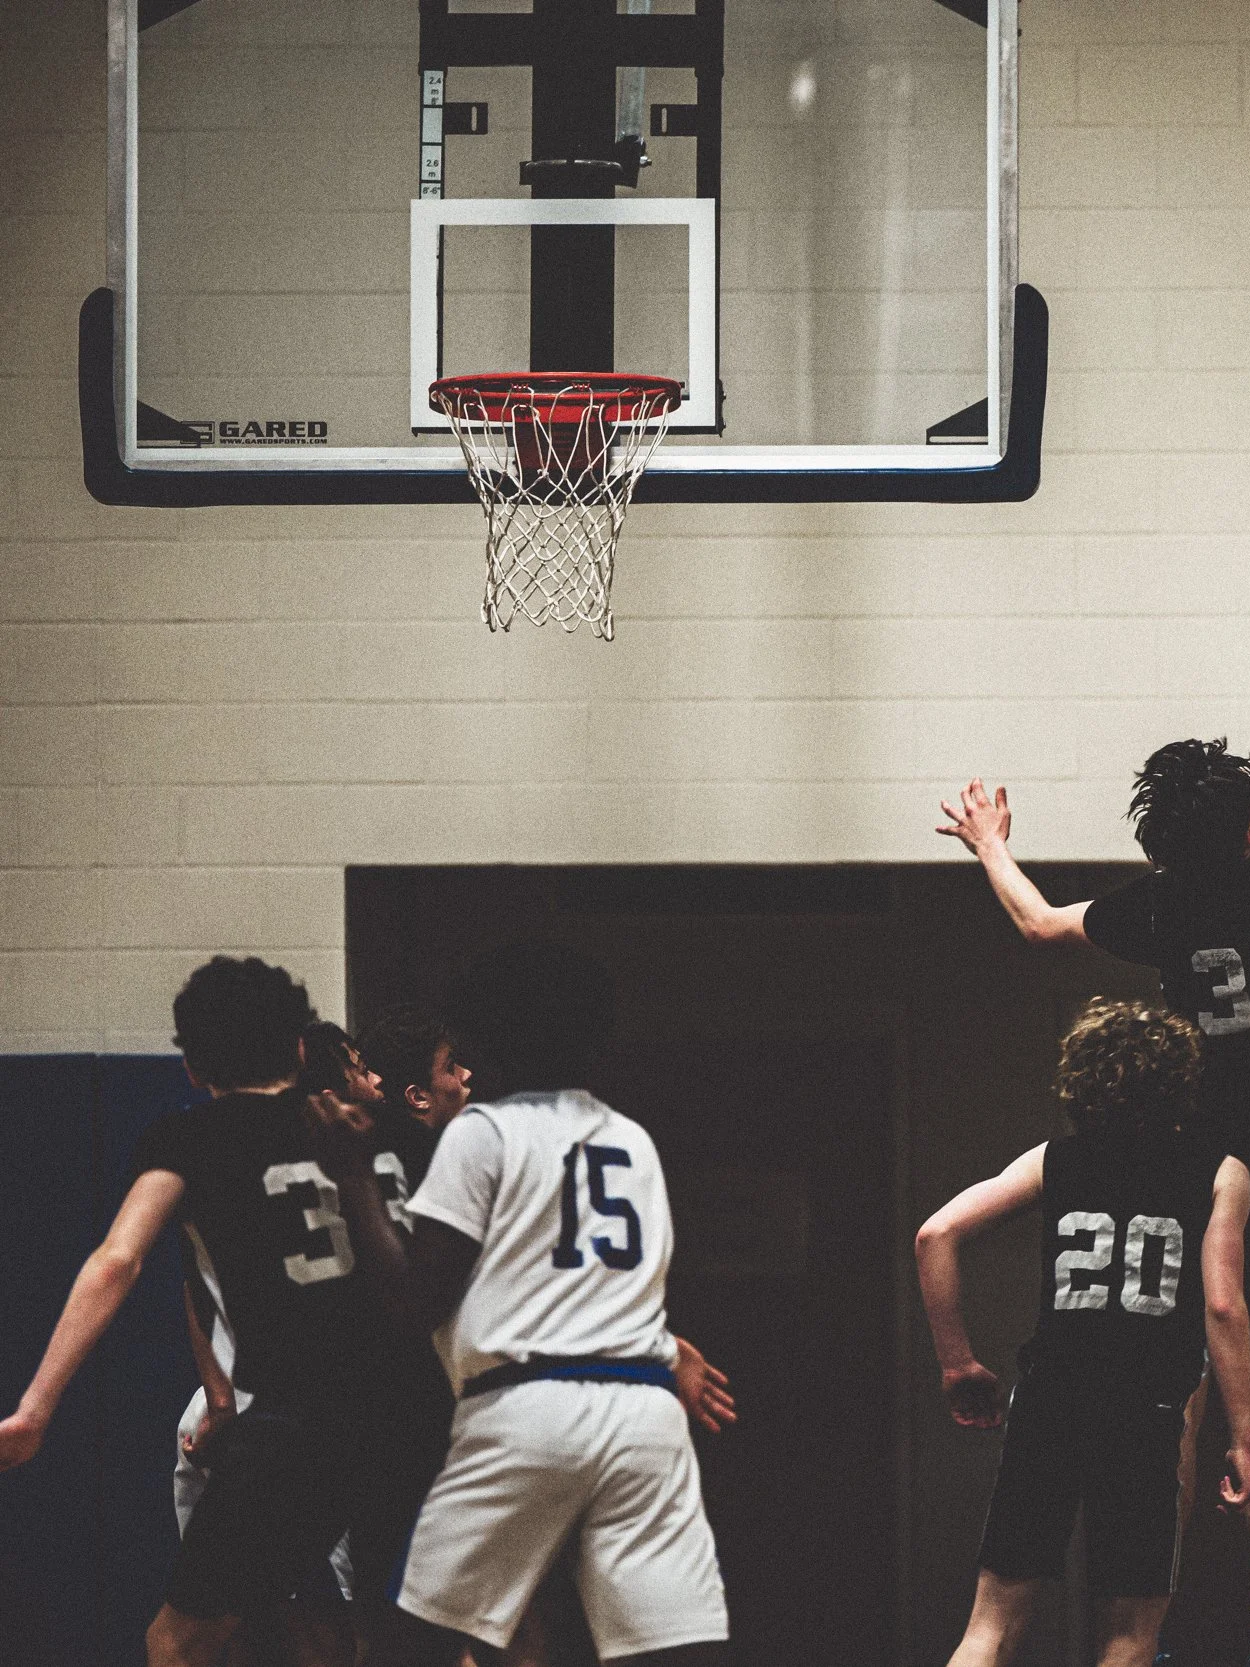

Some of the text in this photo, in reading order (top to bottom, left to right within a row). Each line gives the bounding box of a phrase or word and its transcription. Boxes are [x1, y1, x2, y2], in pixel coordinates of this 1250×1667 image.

[429, 76, 442, 85] 2.4
[426, 159, 439, 168] 2.6
[219, 421, 328, 438] GARED
[262, 1161, 356, 1286] 3
[551, 1141, 644, 1271] 15
[1054, 1211, 1183, 1316] 20
